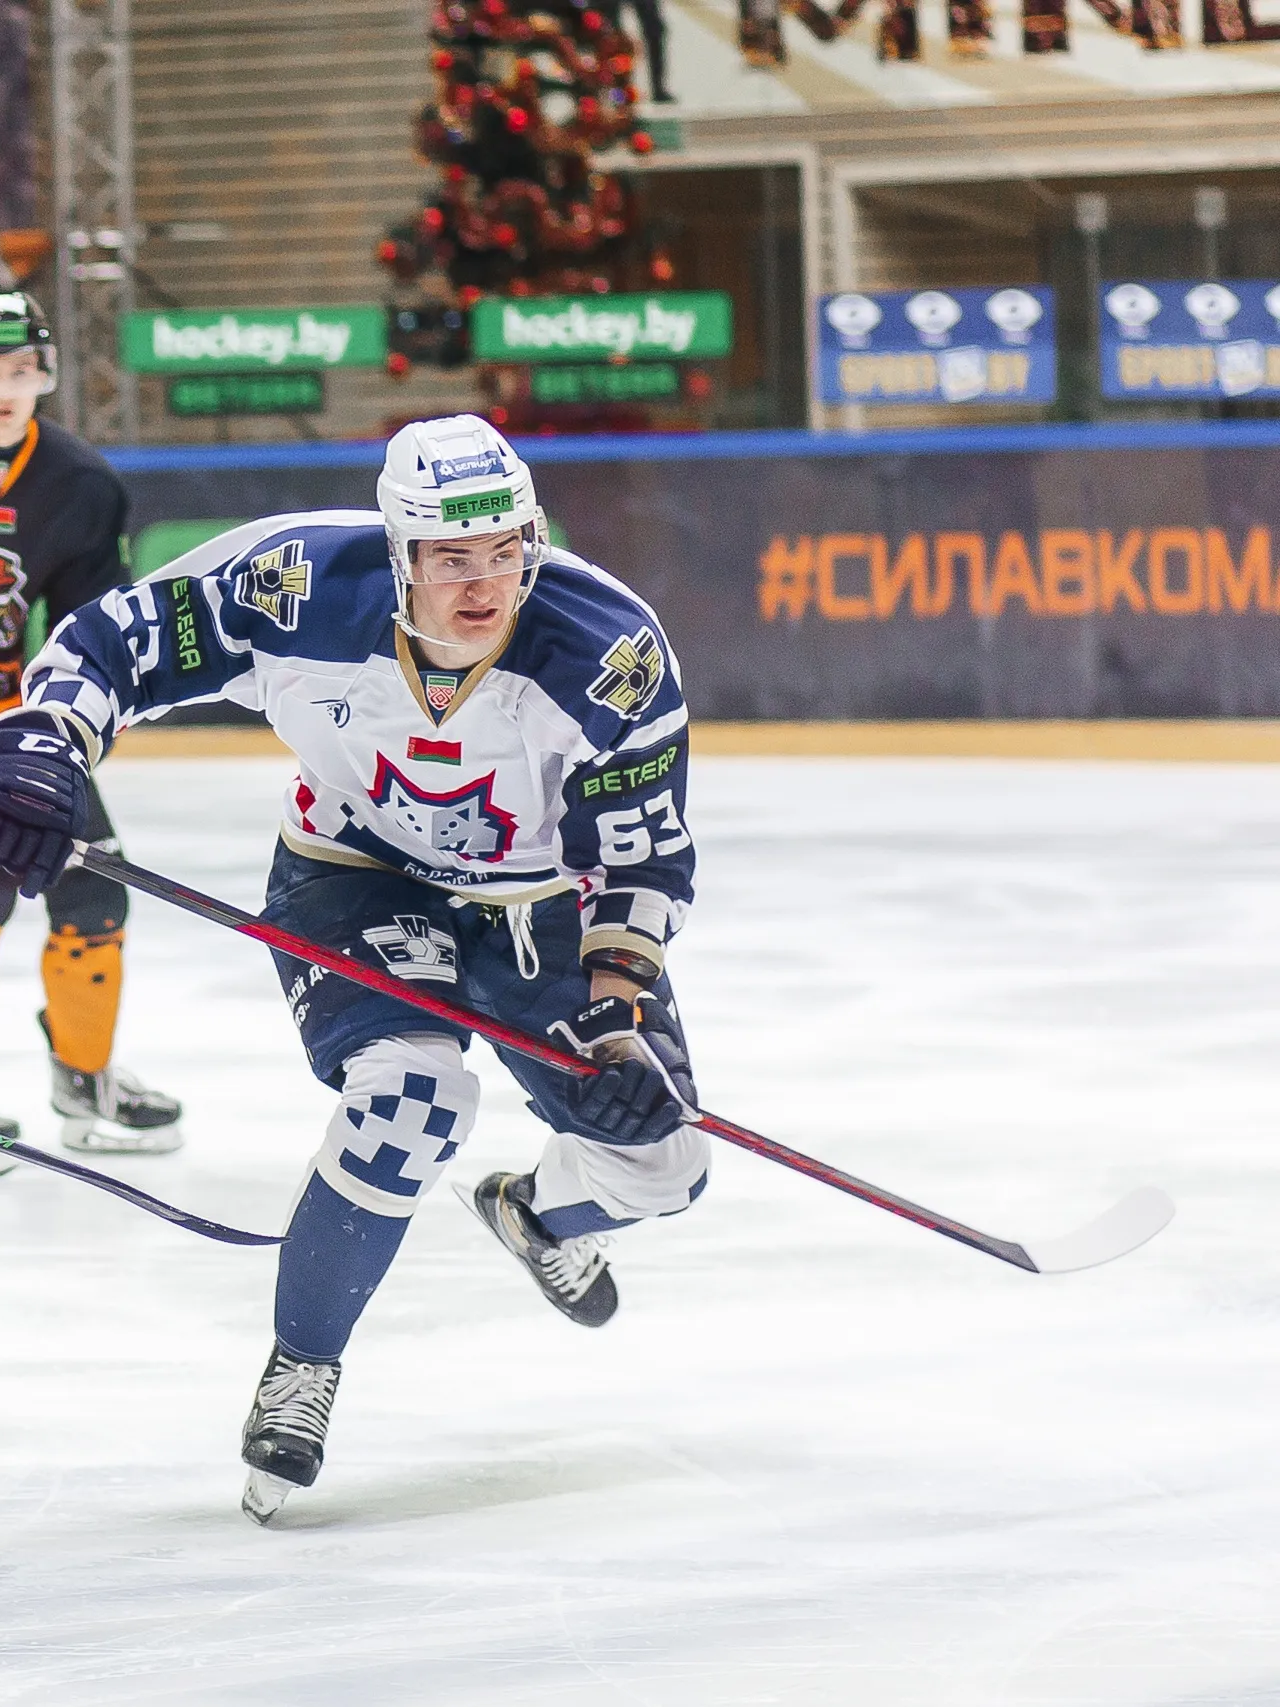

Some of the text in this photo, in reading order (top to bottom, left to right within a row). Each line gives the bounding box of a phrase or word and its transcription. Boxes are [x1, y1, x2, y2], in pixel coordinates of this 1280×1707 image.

[153, 312, 350, 365] hockey.by
[503, 299, 696, 355] hockey.by
[445, 494, 511, 516] BETERA
[757, 526, 1280, 622] #СИЛАВКОМ
[172, 577, 202, 671] ETERA
[595, 788, 692, 867] 63
[578, 998, 615, 1022] CCM
